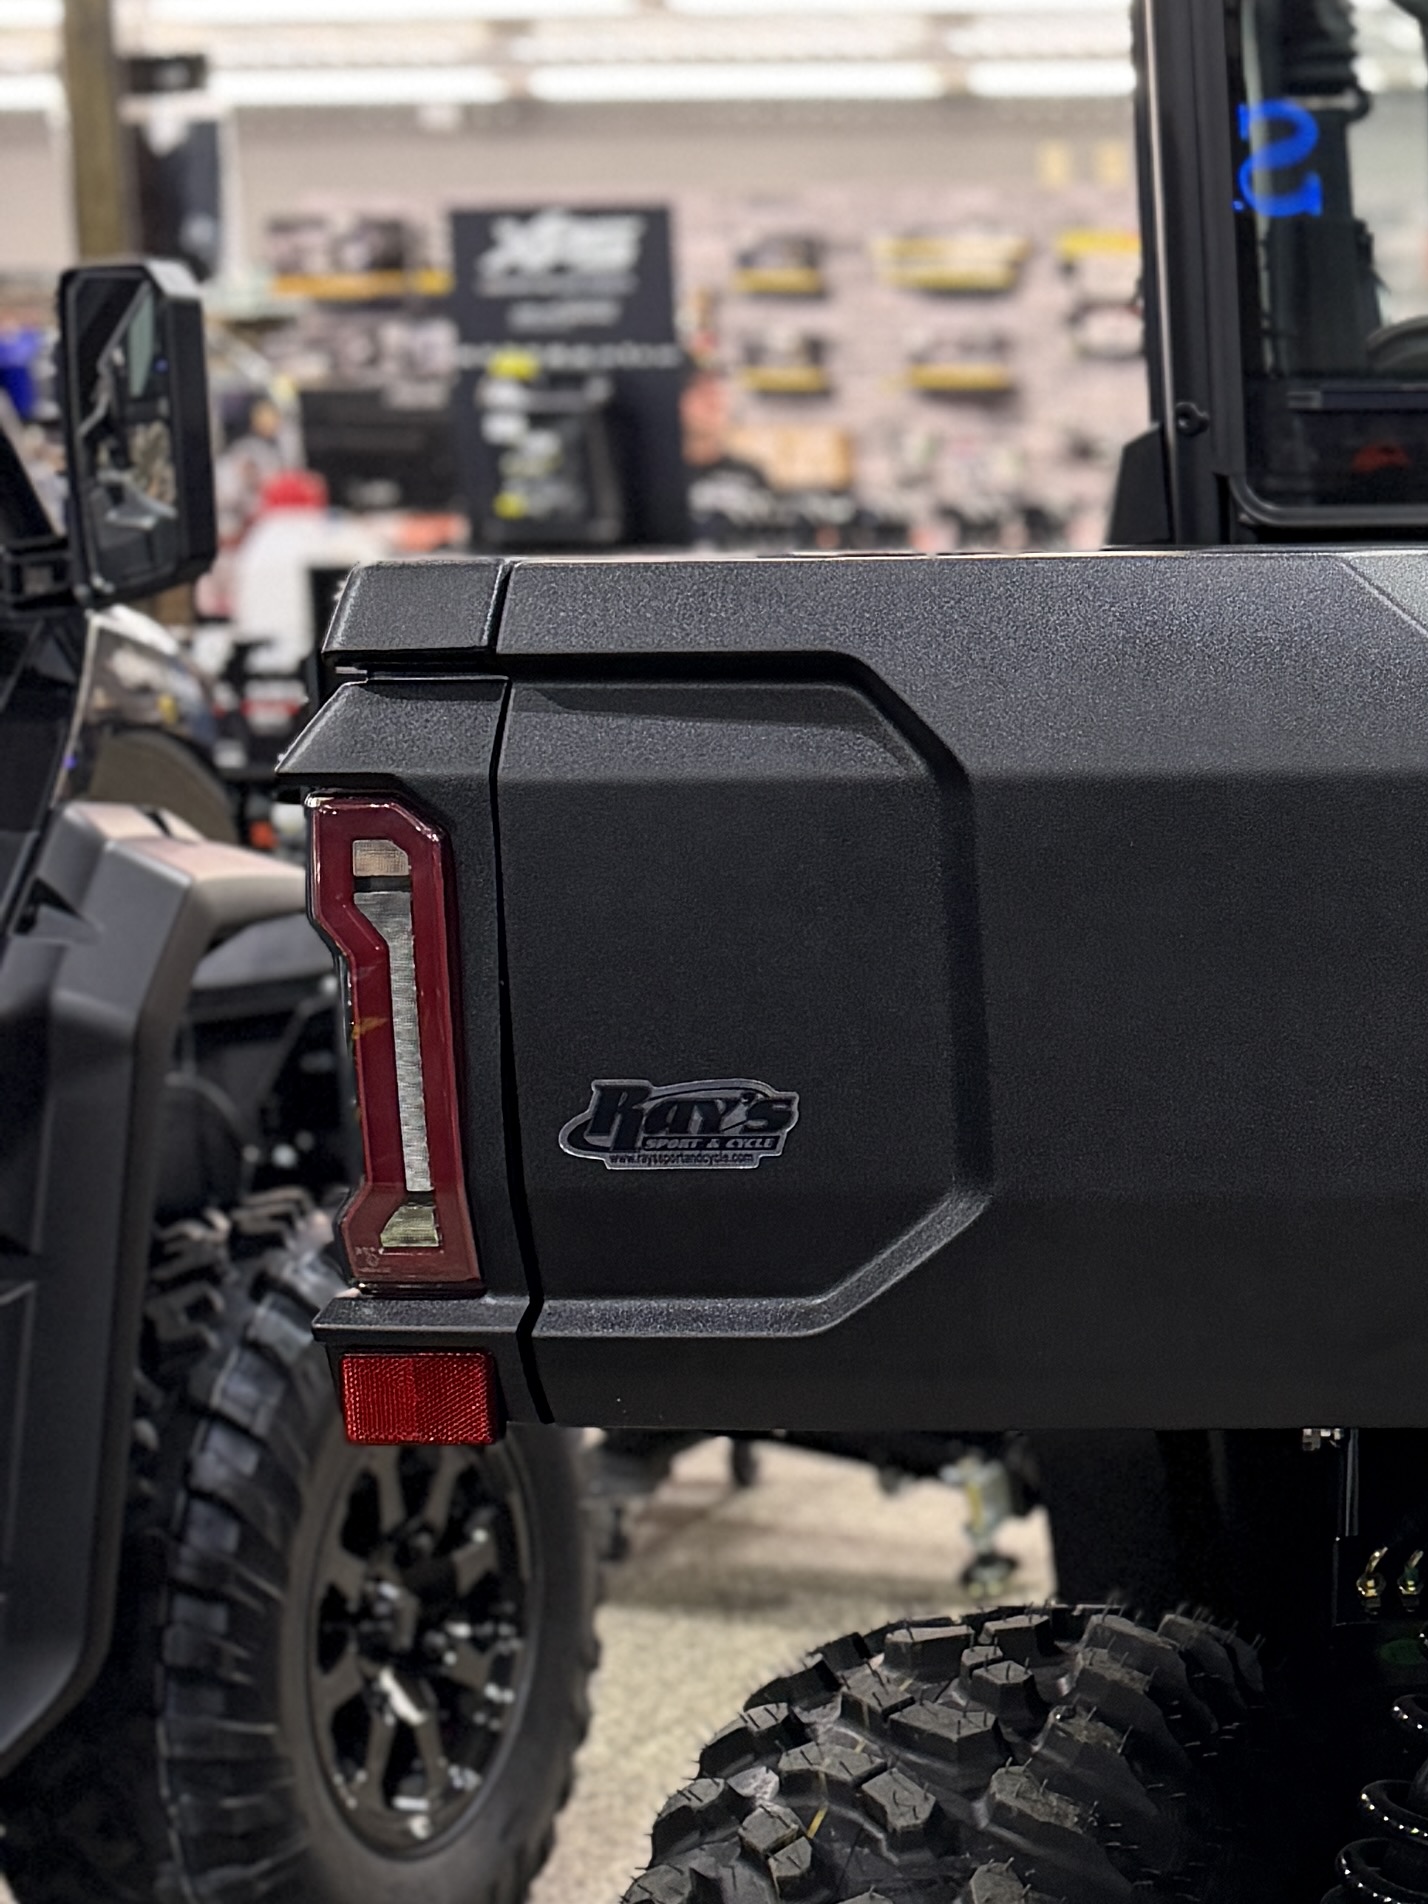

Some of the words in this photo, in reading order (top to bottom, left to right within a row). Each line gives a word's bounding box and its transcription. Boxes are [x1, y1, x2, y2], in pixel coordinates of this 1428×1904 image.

[645, 1138, 701, 1149] SPORT
[706, 1138, 720, 1148] &
[725, 1138, 776, 1148] CYCLE
